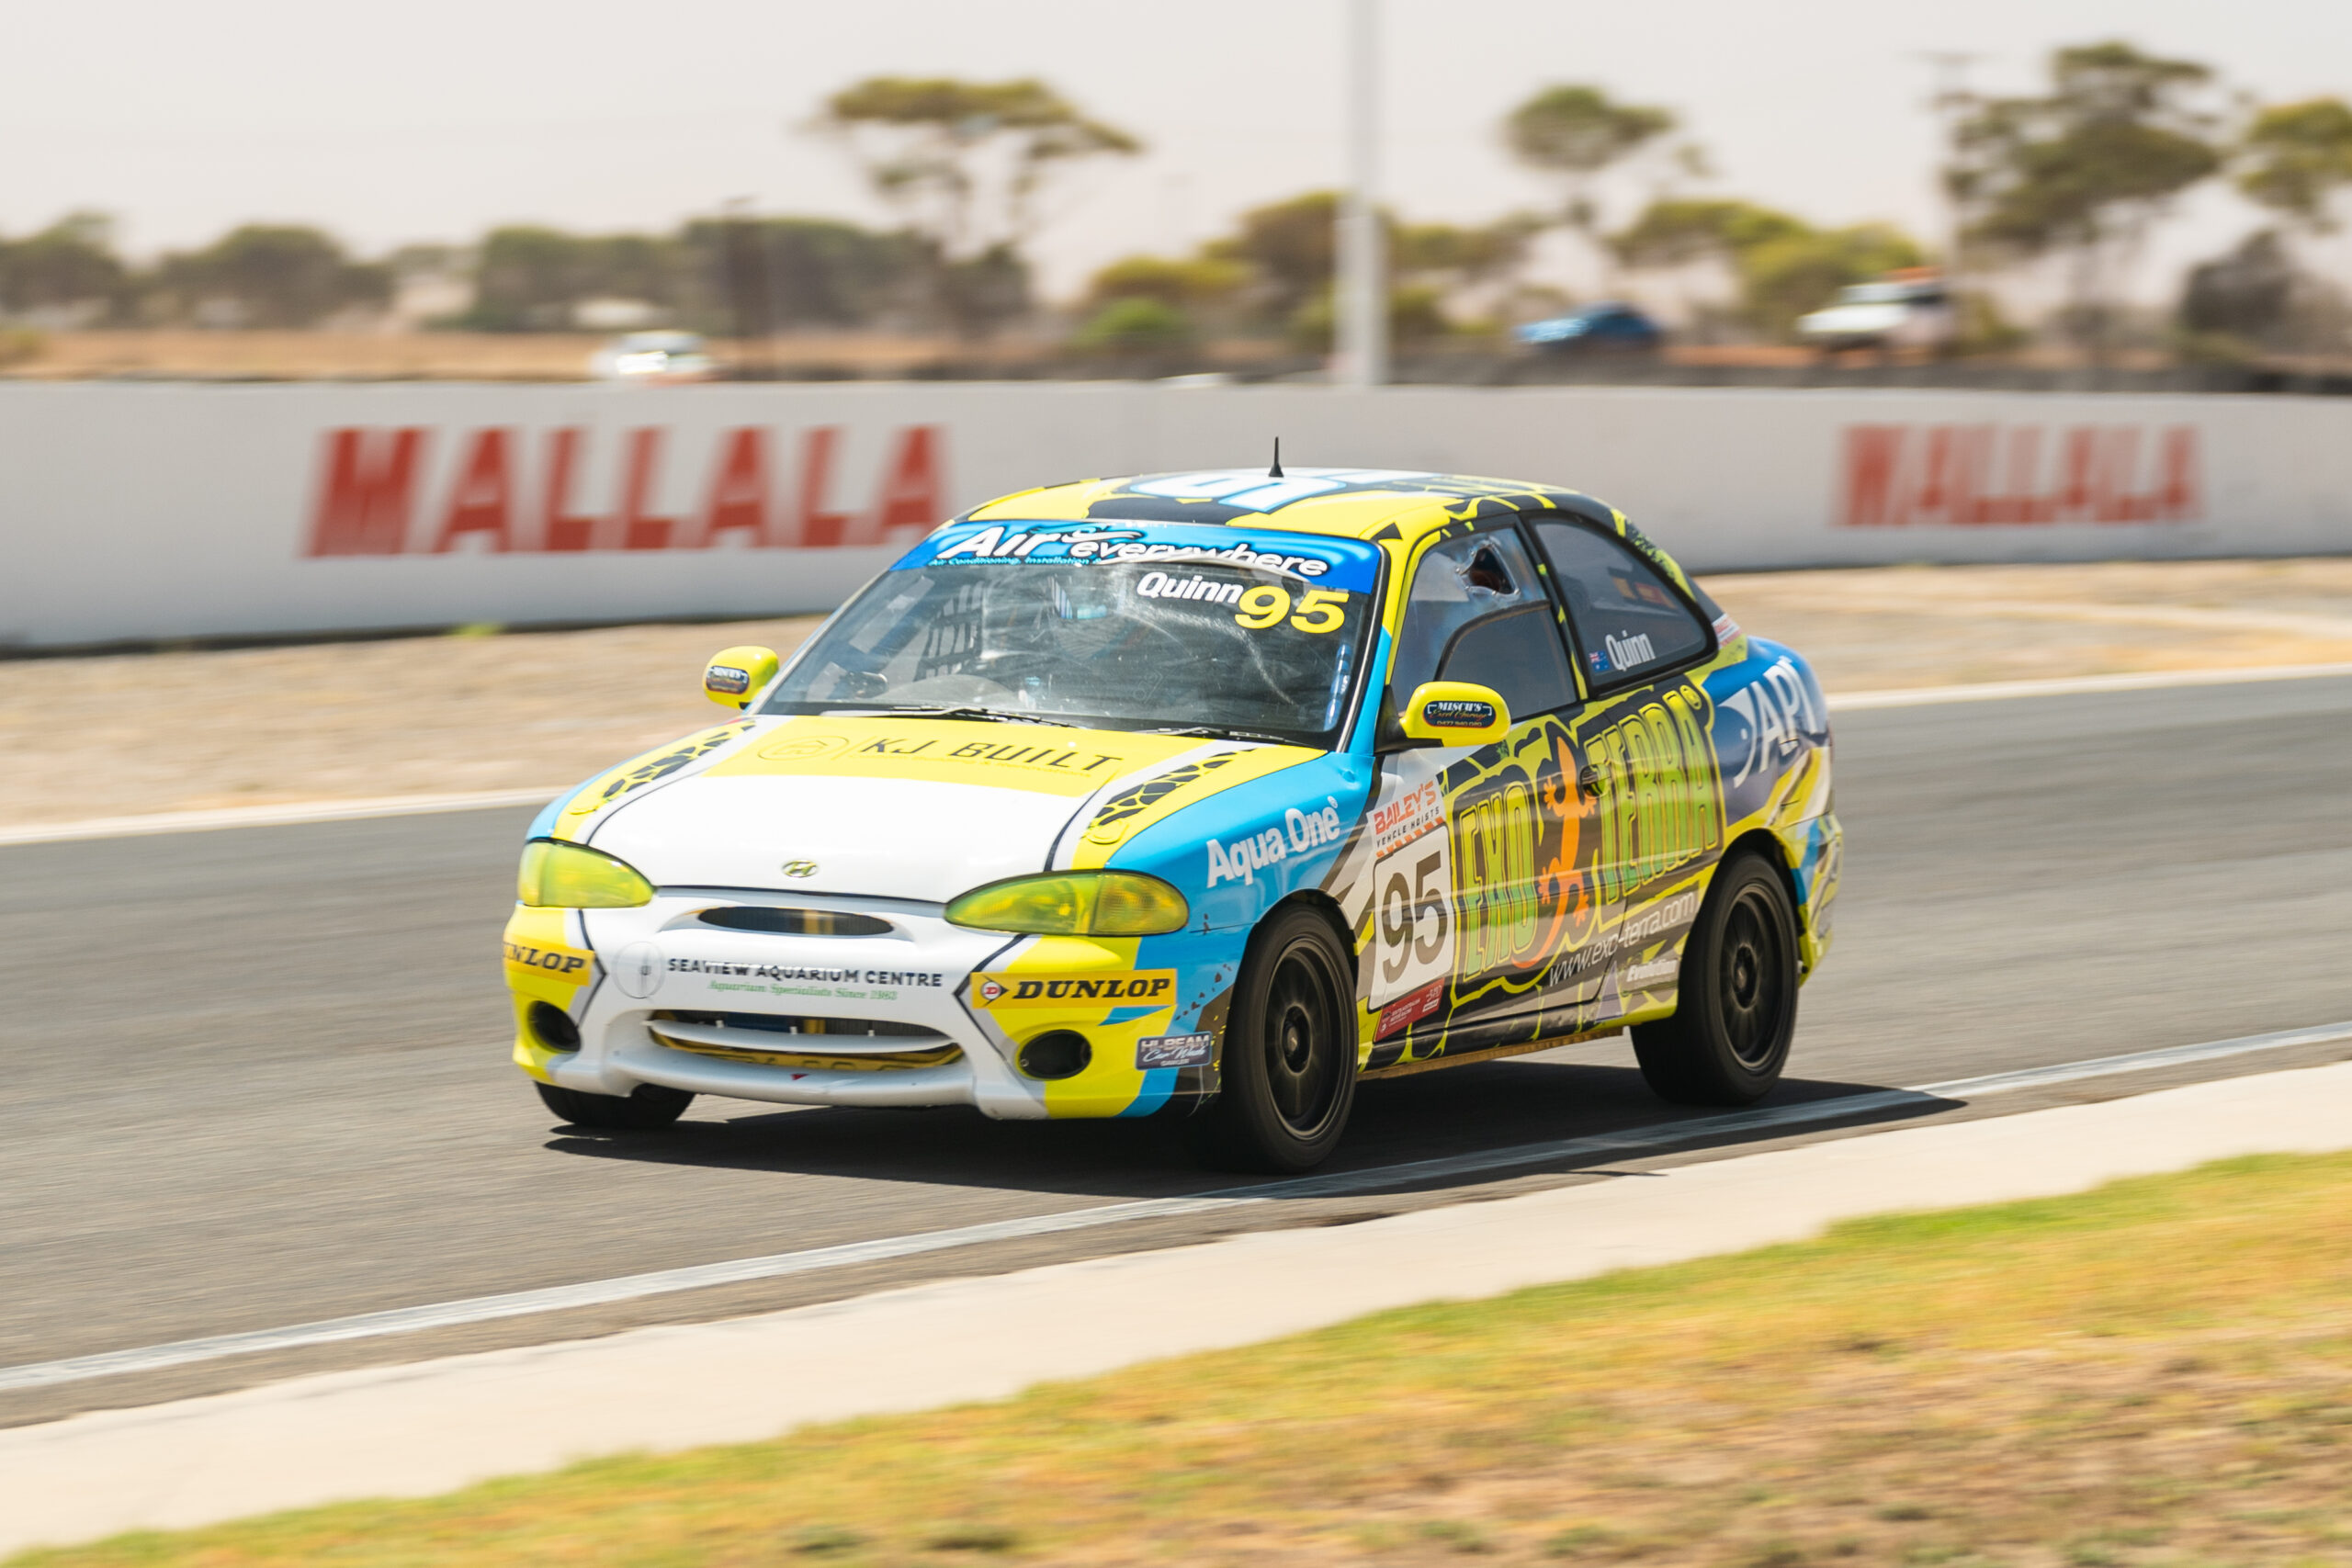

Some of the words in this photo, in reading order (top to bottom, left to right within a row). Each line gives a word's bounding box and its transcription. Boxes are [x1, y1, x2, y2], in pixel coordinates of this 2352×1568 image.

[305, 425, 948, 558] MALLALA
[936, 525, 1061, 558] Air
[1069, 540, 1329, 578] everywhere
[1136, 571, 1244, 604] Quinn
[1235, 585, 1350, 634] 95
[1604, 629, 1656, 673] Quinn
[860, 739, 939, 754] KJ
[948, 742, 1124, 771] BUILT
[1374, 780, 1437, 835] BAILEY'S
[1410, 806, 1440, 830] HOISTS
[1206, 828, 1283, 888] Aqua
[1284, 807, 1340, 852] One
[1460, 780, 1539, 981] EXO
[1583, 687, 1720, 904] TERRA
[1381, 851, 1446, 985] 95
[668, 958, 749, 976] SEAVIEW
[756, 964, 859, 983] AQUARIUM
[865, 969, 943, 987] CENTRE
[707, 979, 768, 994] Aquarium
[834, 987, 866, 999] Since
[1012, 978, 1170, 999] DUNLOP
